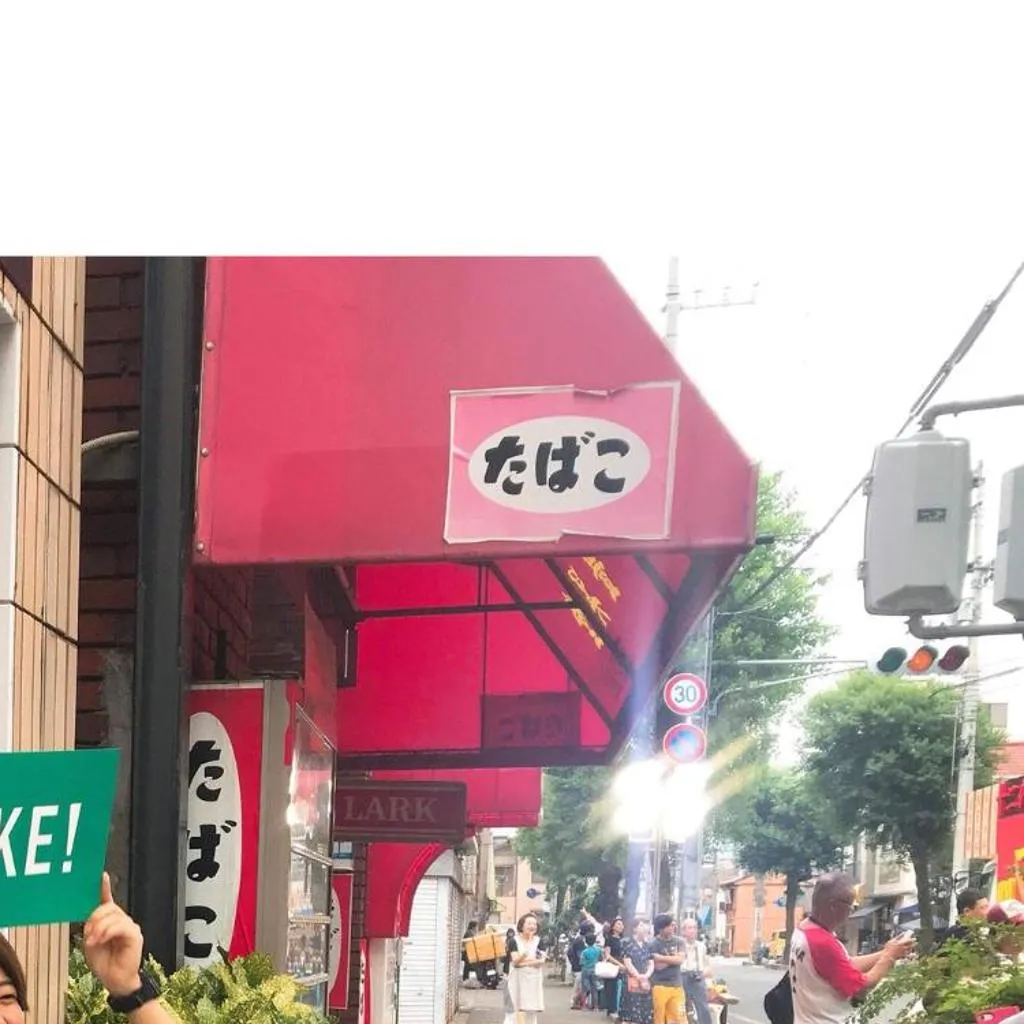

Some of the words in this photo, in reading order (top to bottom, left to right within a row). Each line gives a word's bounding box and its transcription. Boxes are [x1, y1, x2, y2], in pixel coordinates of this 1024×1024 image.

[484, 430, 630, 495] たばこ
[674, 685, 697, 703] 30
[343, 795, 440, 824] LARK
[185, 740, 237, 958] たばこ
